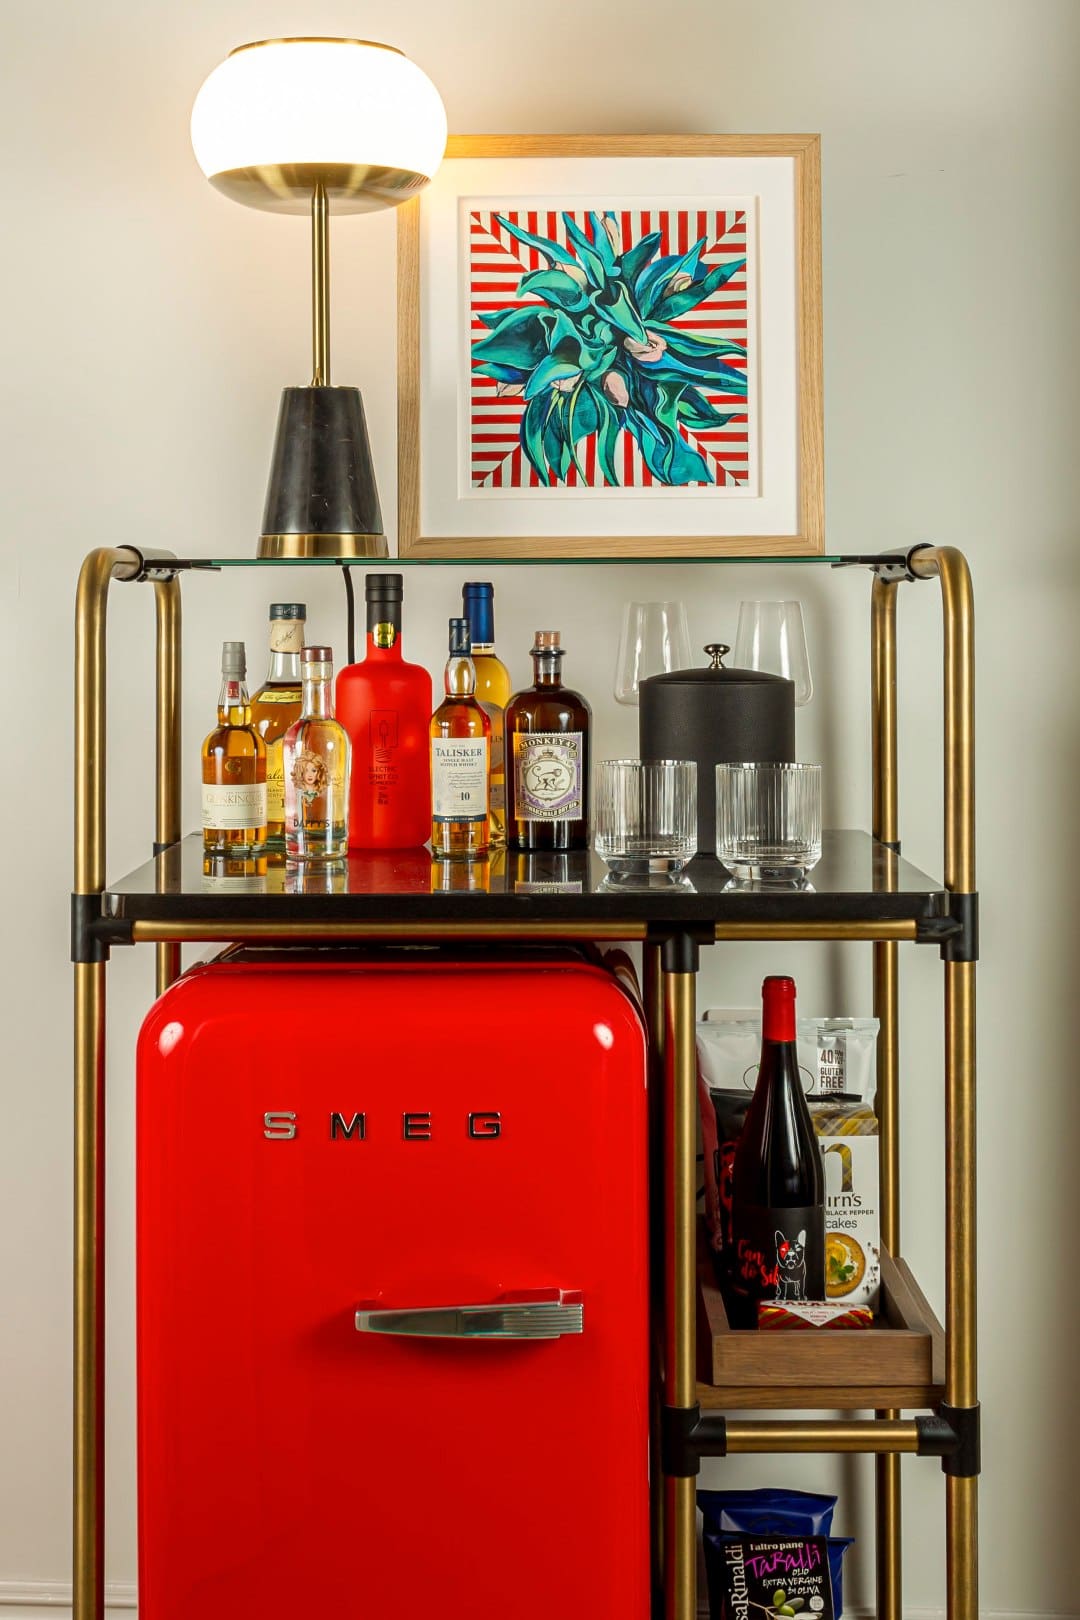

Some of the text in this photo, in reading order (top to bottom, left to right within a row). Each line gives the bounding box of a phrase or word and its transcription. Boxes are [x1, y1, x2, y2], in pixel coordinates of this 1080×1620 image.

[520, 737, 577, 750] MONKEY 47
[435, 747, 482, 757] TALISKER
[461, 791, 470, 801] 10
[820, 1067, 844, 1076] GLUTEN
[820, 1076, 844, 1089] FREE
[779, 1542, 804, 1551] pane
[792, 1567, 810, 1576] OLIO
[762, 1575, 823, 1589] EXTRA VERGINE
[797, 1585, 820, 1595] OLIVA
